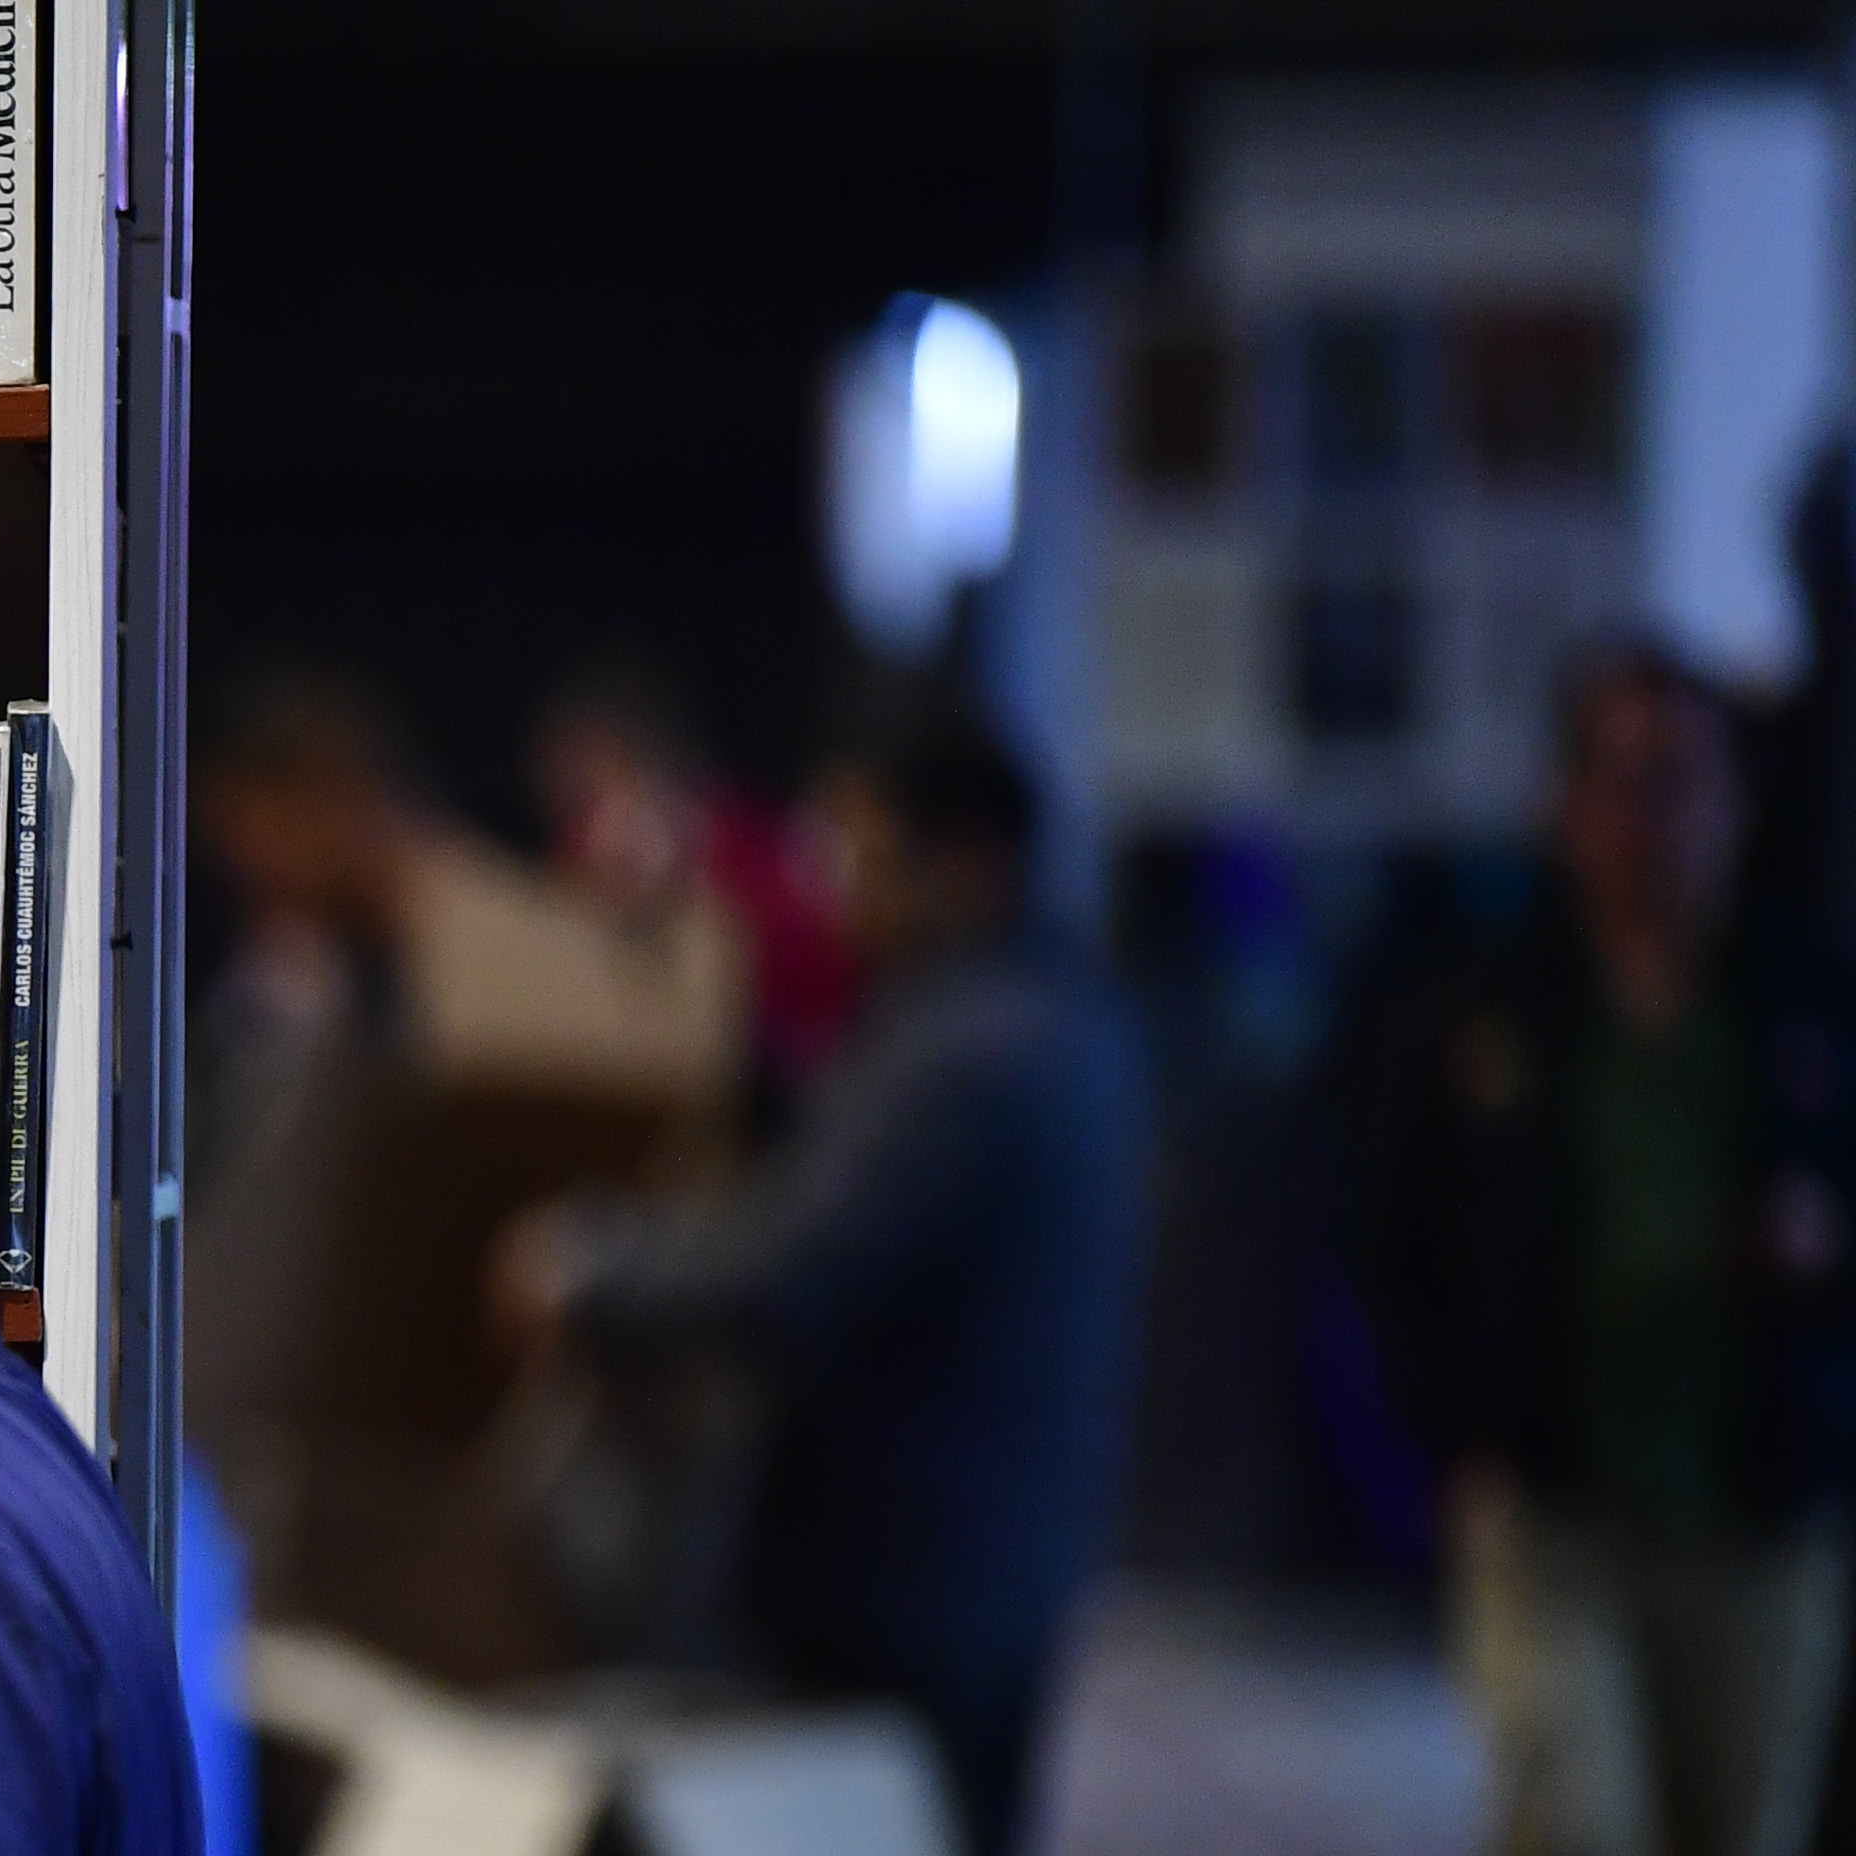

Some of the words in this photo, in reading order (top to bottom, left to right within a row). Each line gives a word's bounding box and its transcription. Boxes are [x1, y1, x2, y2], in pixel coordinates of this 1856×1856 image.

[17, 752, 38, 827] SÁNCHEZ
[15, 831, 35, 939] CUAUHTÉMOC
[16, 944, 33, 1007] CARLOS
